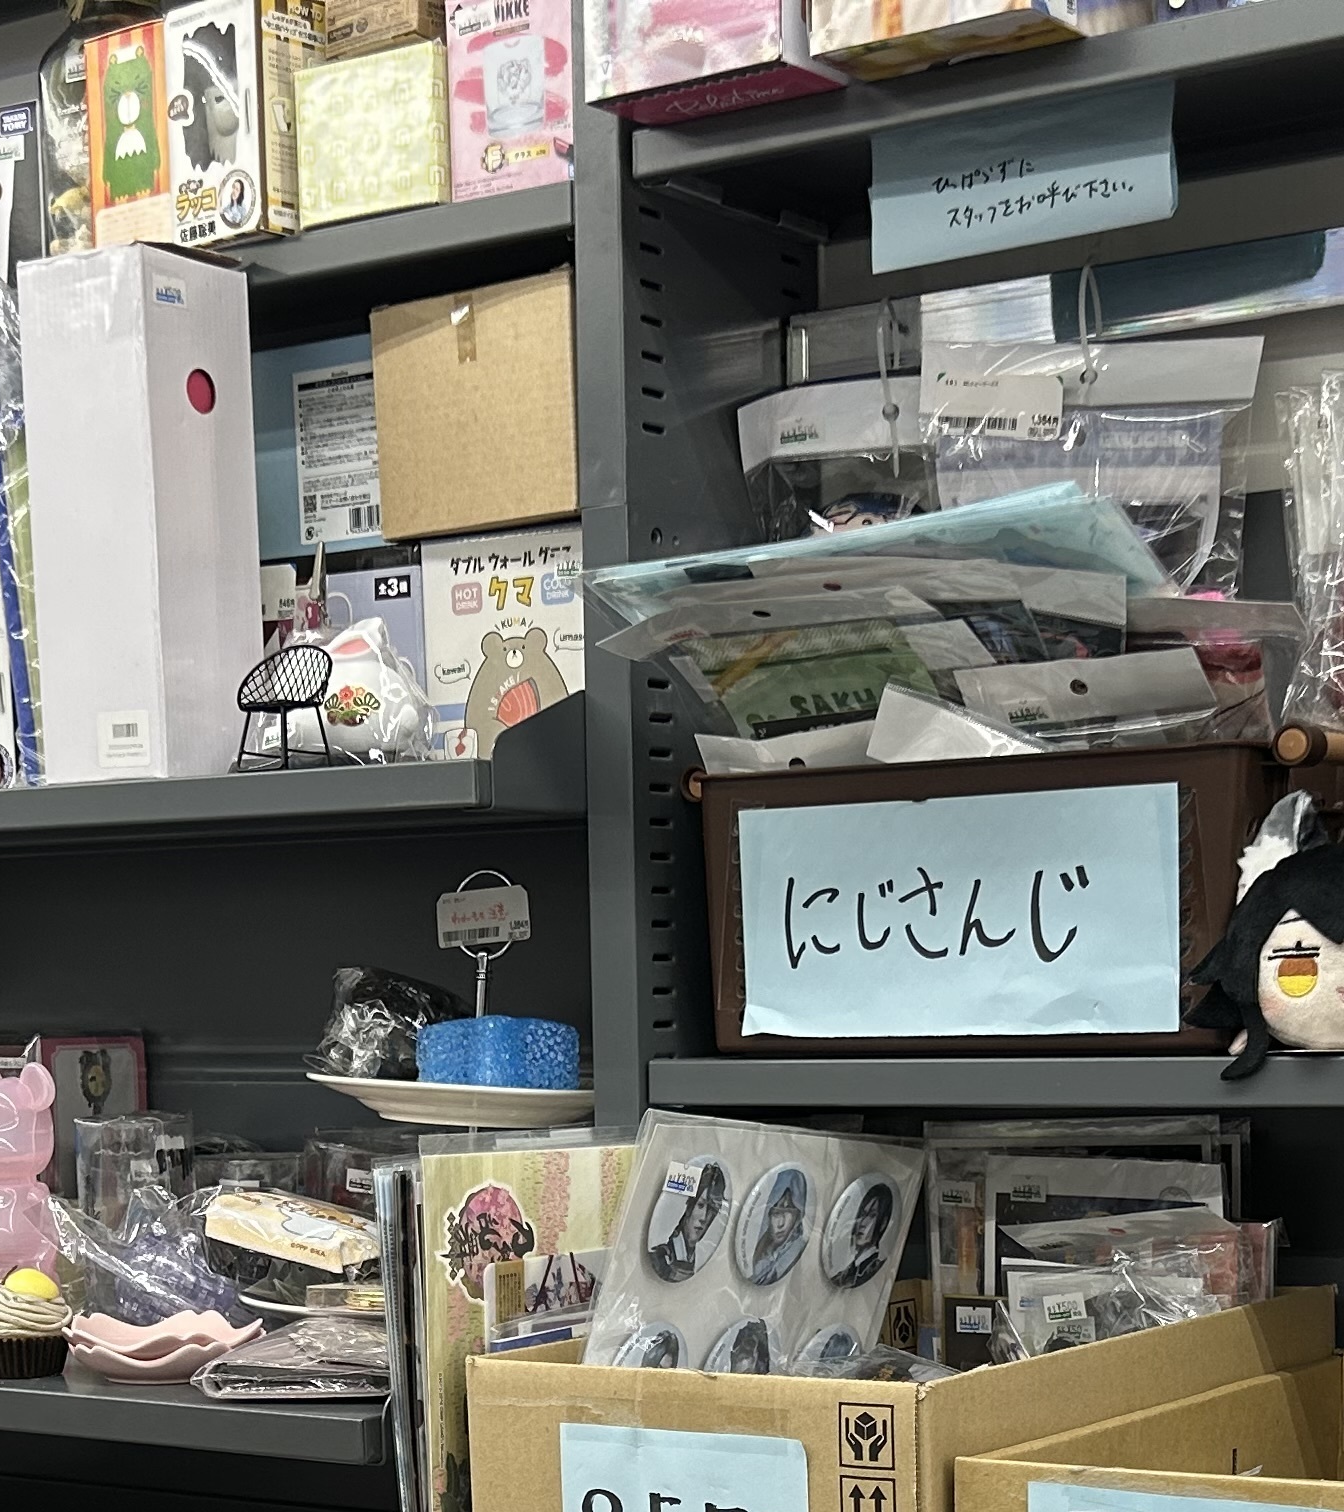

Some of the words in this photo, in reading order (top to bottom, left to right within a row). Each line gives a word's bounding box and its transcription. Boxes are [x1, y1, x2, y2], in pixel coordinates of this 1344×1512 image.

[177, 185, 216, 220] ラッコ
[450, 556, 485, 576] ダブル
[455, 588, 477, 600] HOT
[489, 576, 535, 611] クマ
[500, 616, 528, 629] KUMA
[784, 865, 1091, 969] にじさんじ
